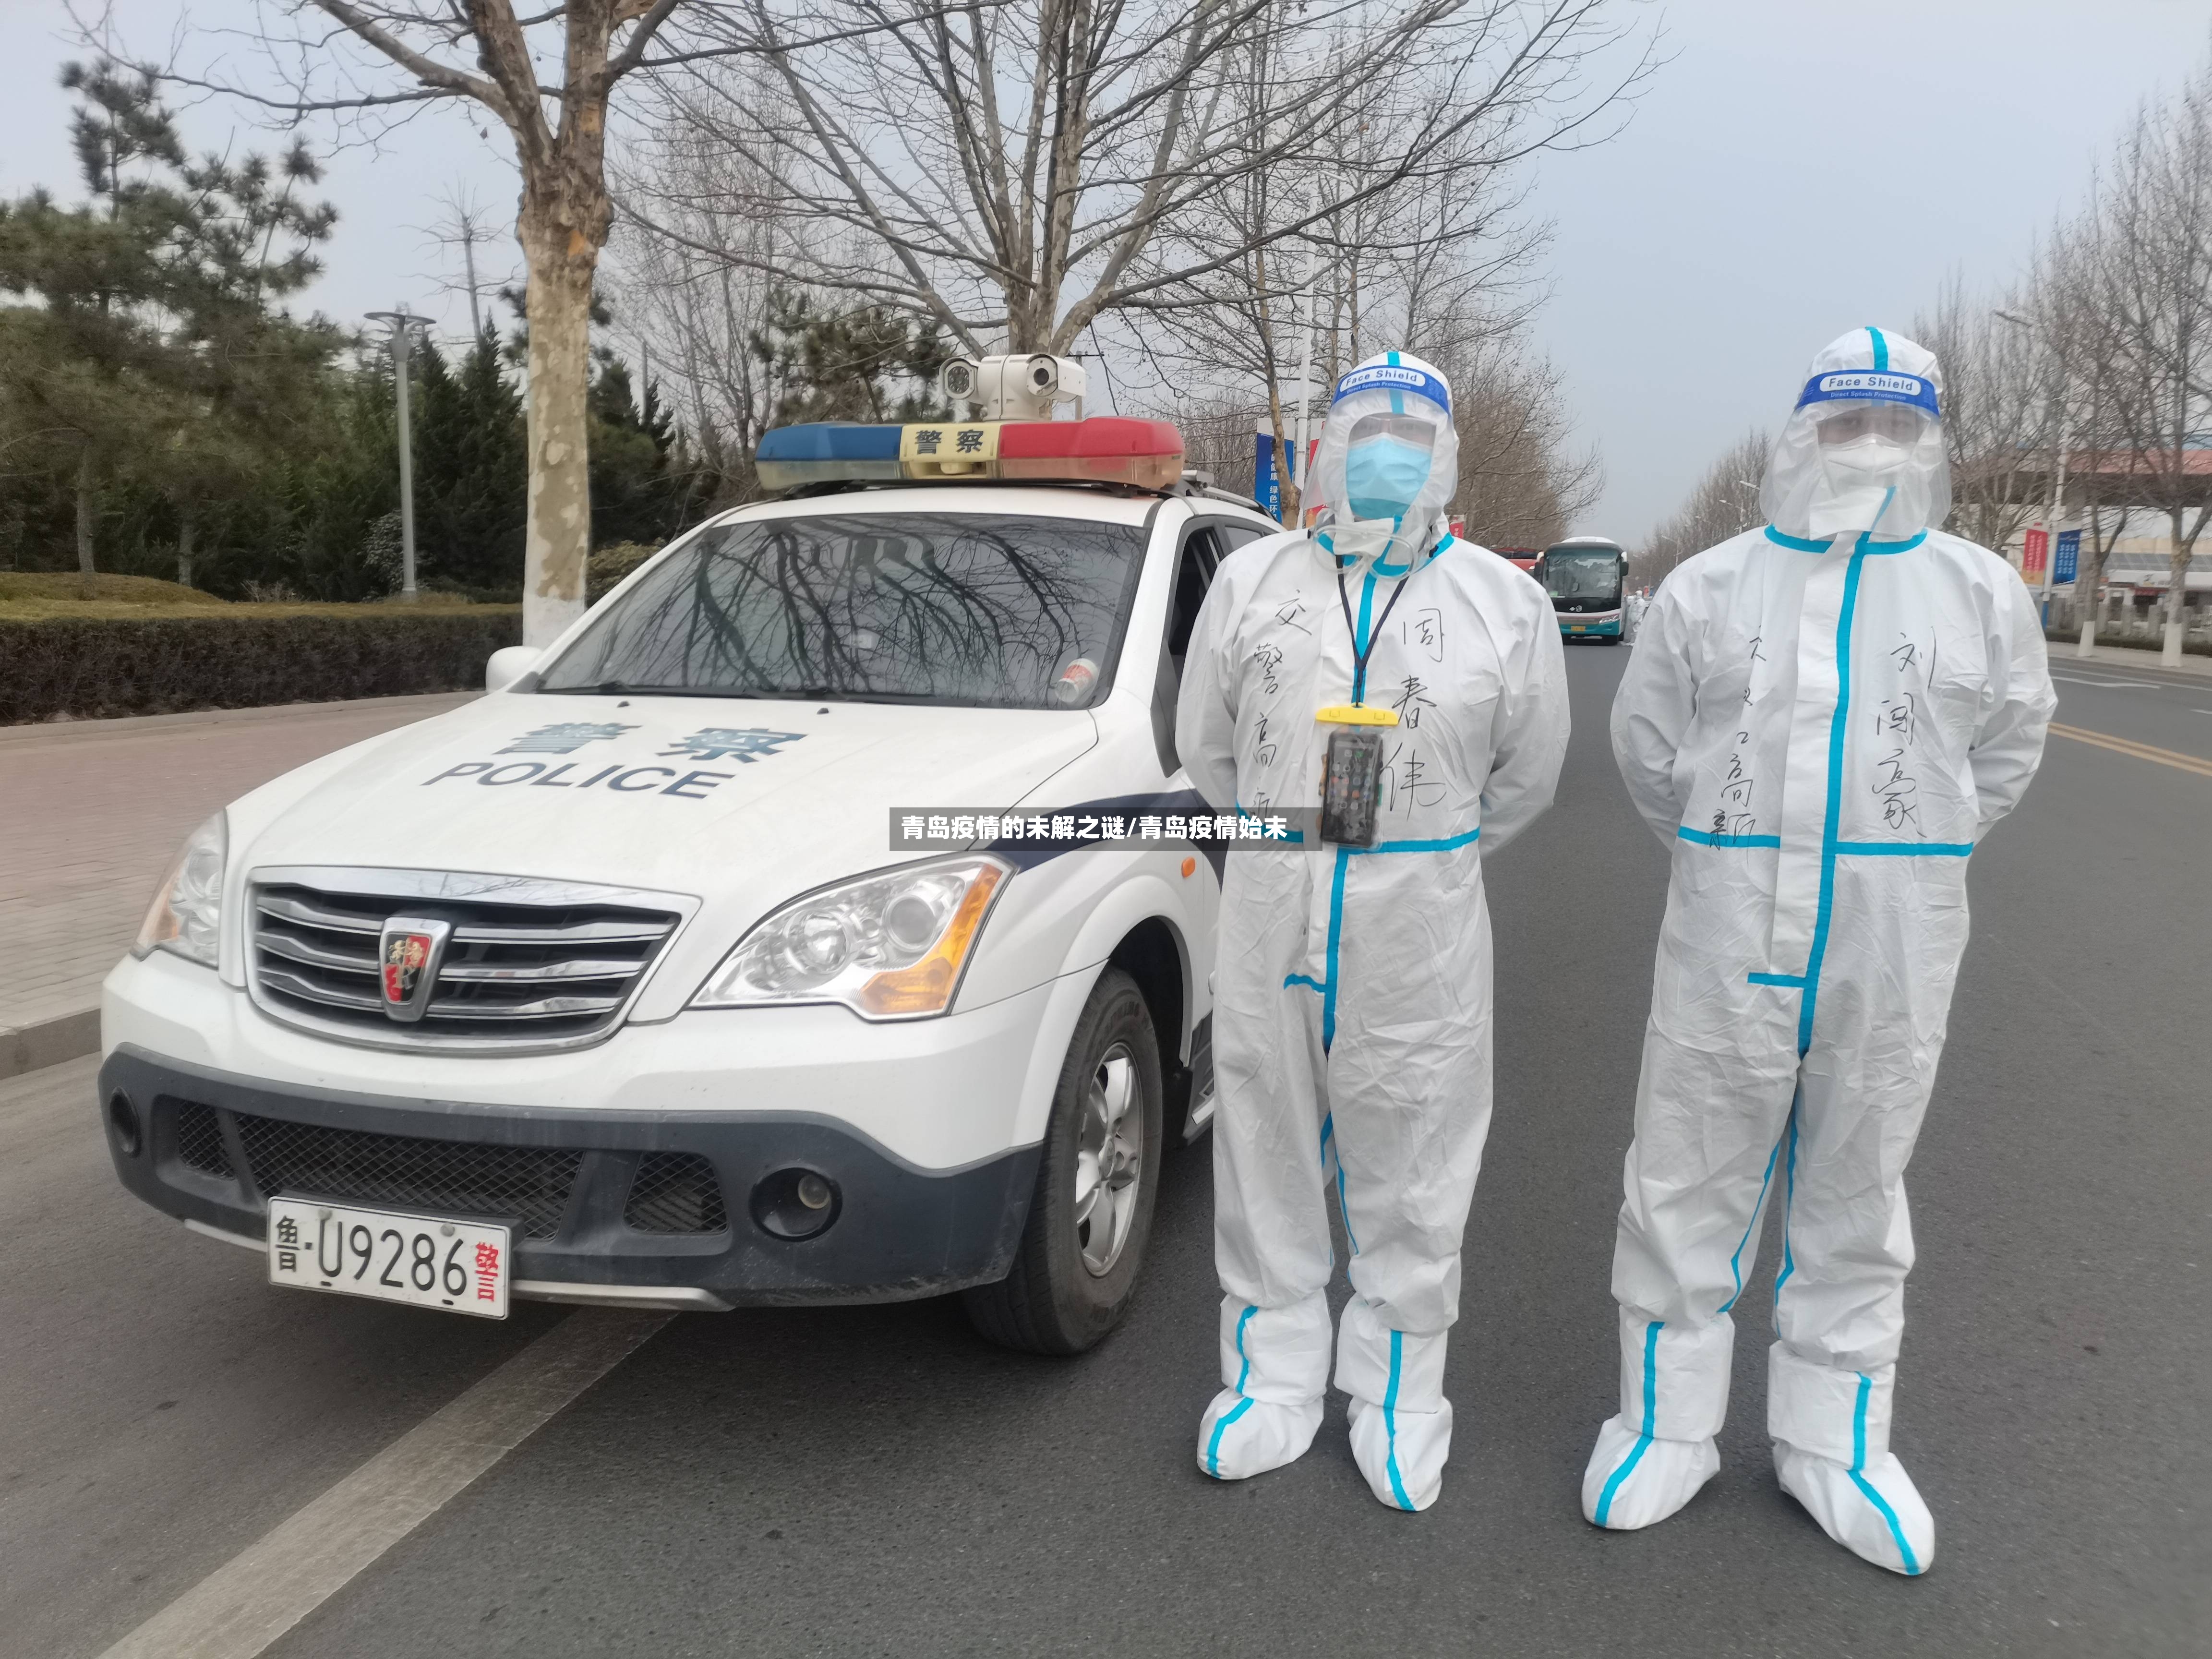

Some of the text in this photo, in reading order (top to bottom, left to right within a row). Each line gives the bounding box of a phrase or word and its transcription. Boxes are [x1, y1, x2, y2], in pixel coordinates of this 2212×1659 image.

[1346, 370, 1417, 386] Face Shield
[1362, 381, 1380, 389] Splash
[1381, 381, 1411, 390] Protection
[1828, 376, 1913, 391] Face Shield
[914, 429, 984, 455] 警察
[492, 722, 808, 763] 警察
[420, 762, 736, 800] POLICE
